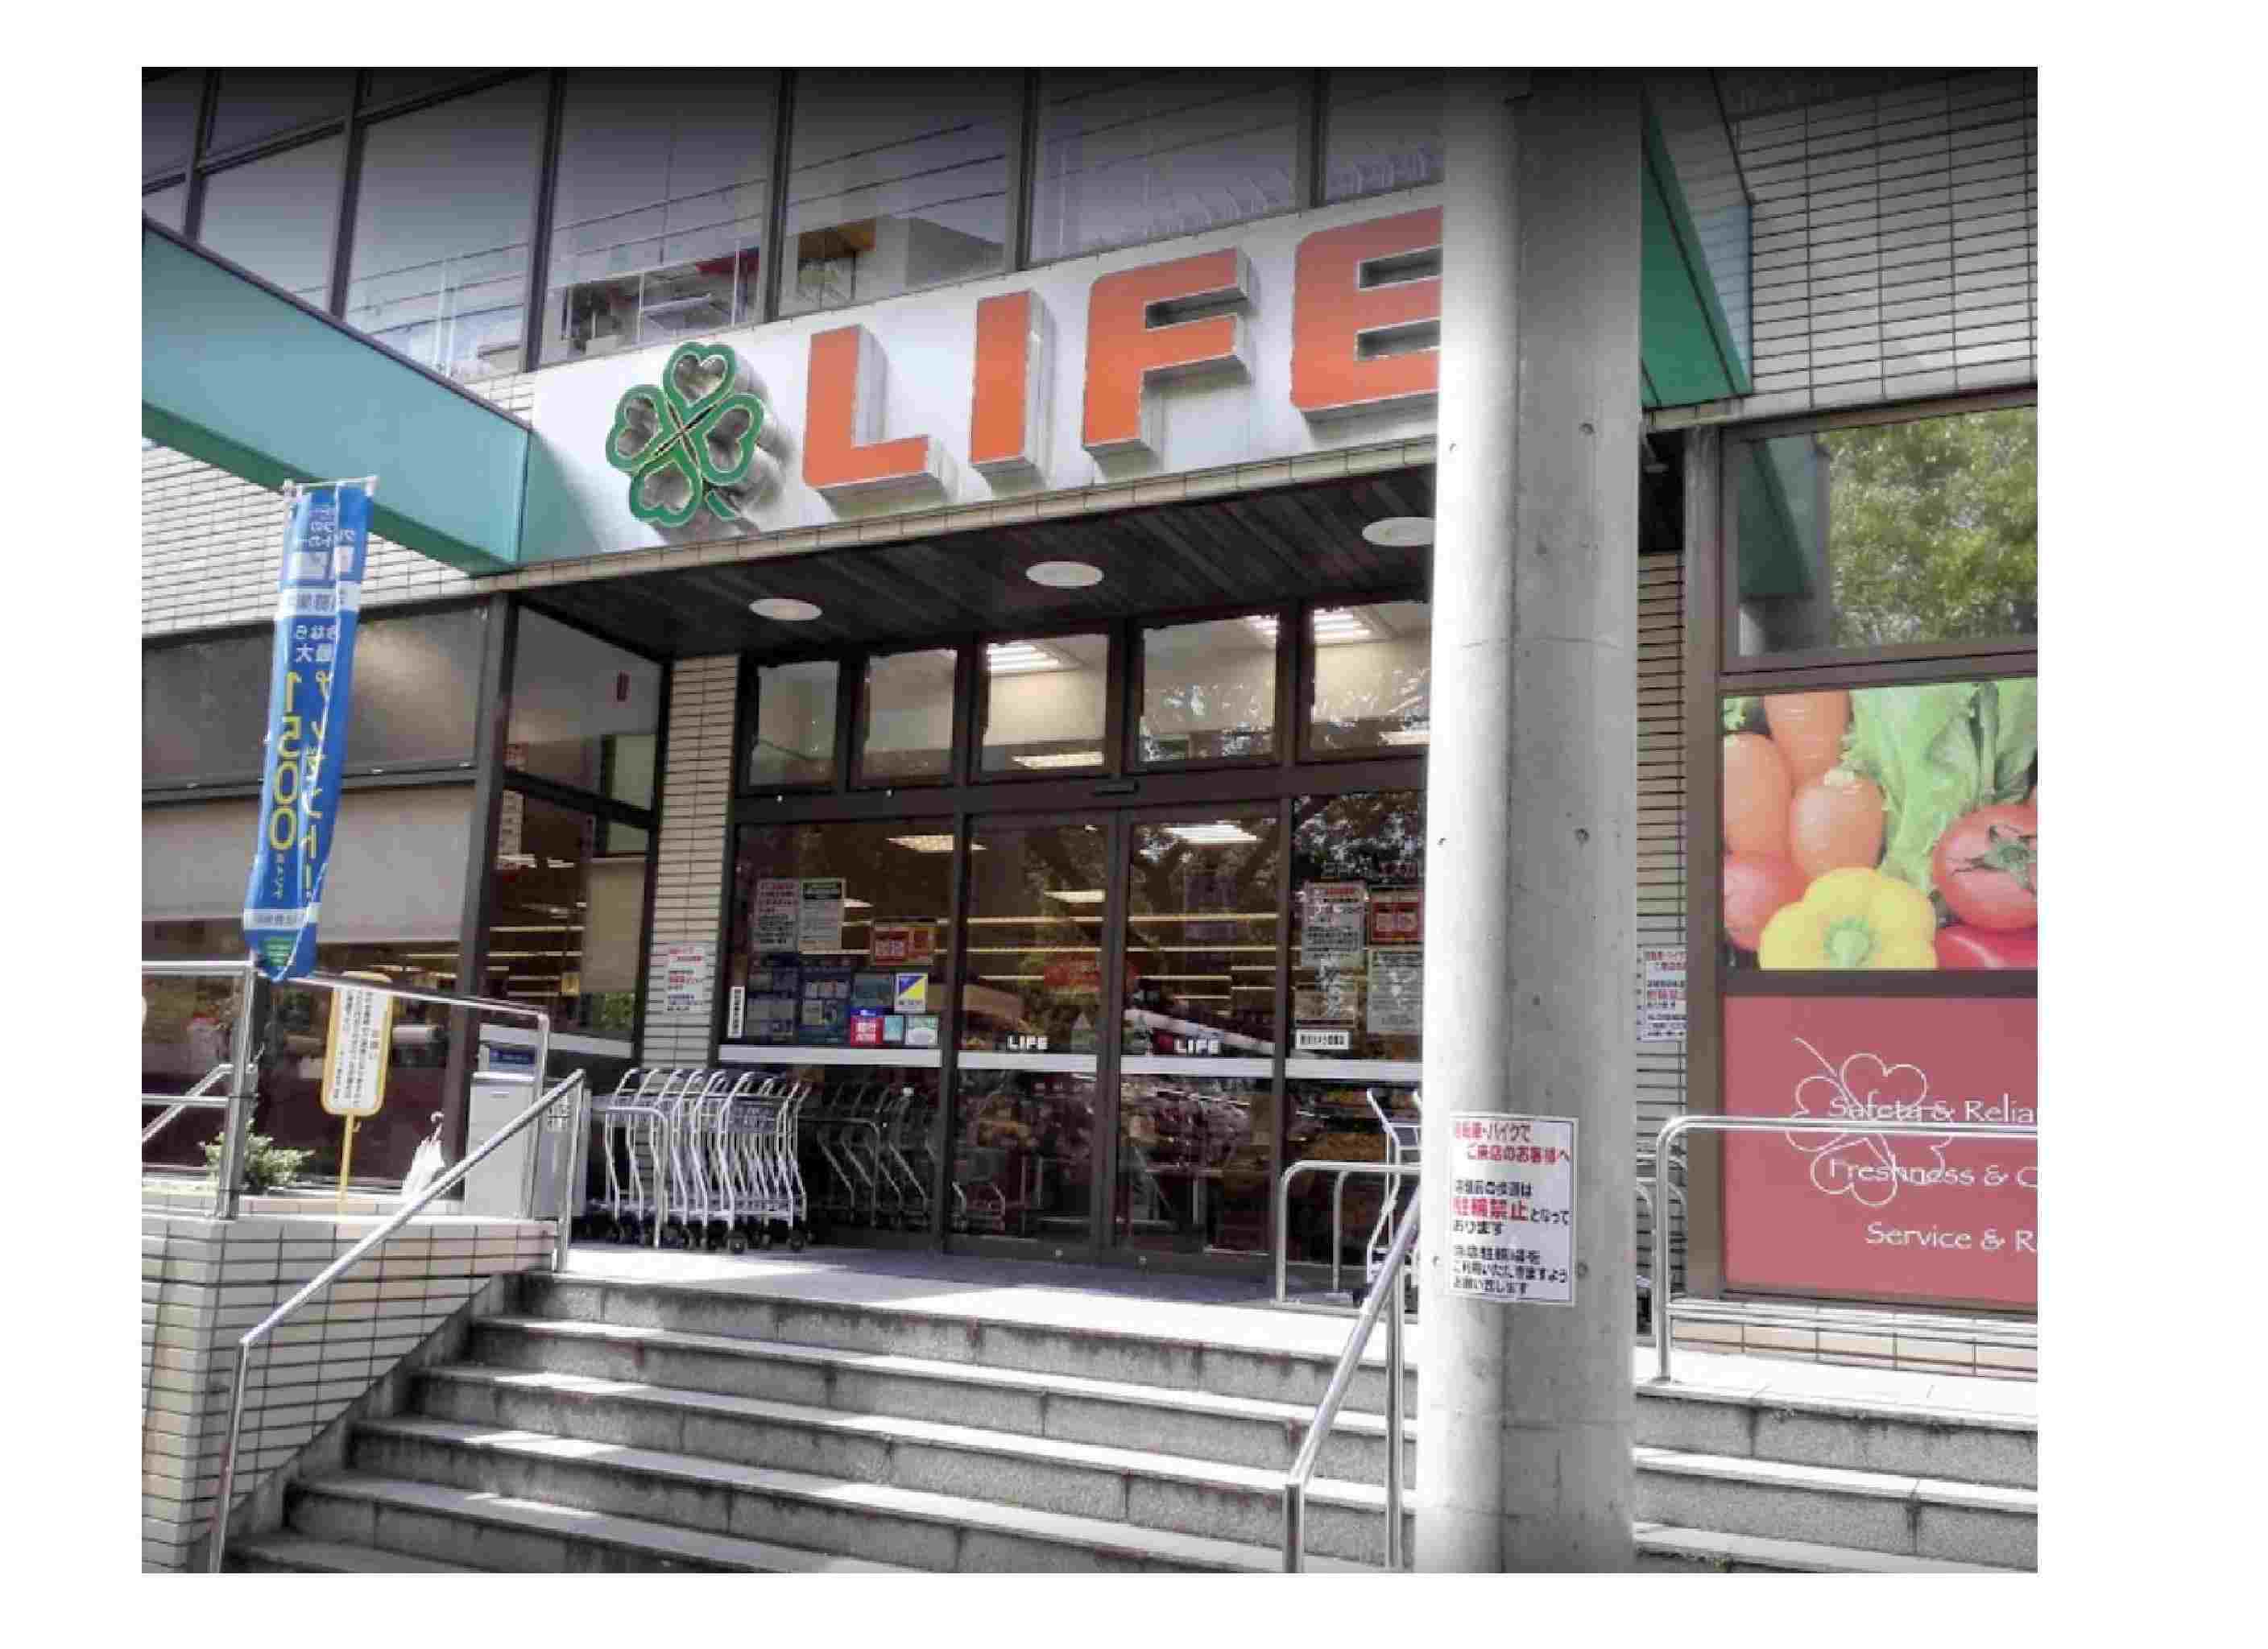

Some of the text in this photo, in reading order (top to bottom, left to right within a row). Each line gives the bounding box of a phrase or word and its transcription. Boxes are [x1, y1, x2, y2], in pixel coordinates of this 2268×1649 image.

[804, 206, 1443, 486] LIFE
[1008, 1035, 1048, 1050] LIFE
[1173, 1038, 1221, 1053] LIFE
[1866, 1221, 1973, 1250] Service
[1980, 1228, 2006, 1251] &
